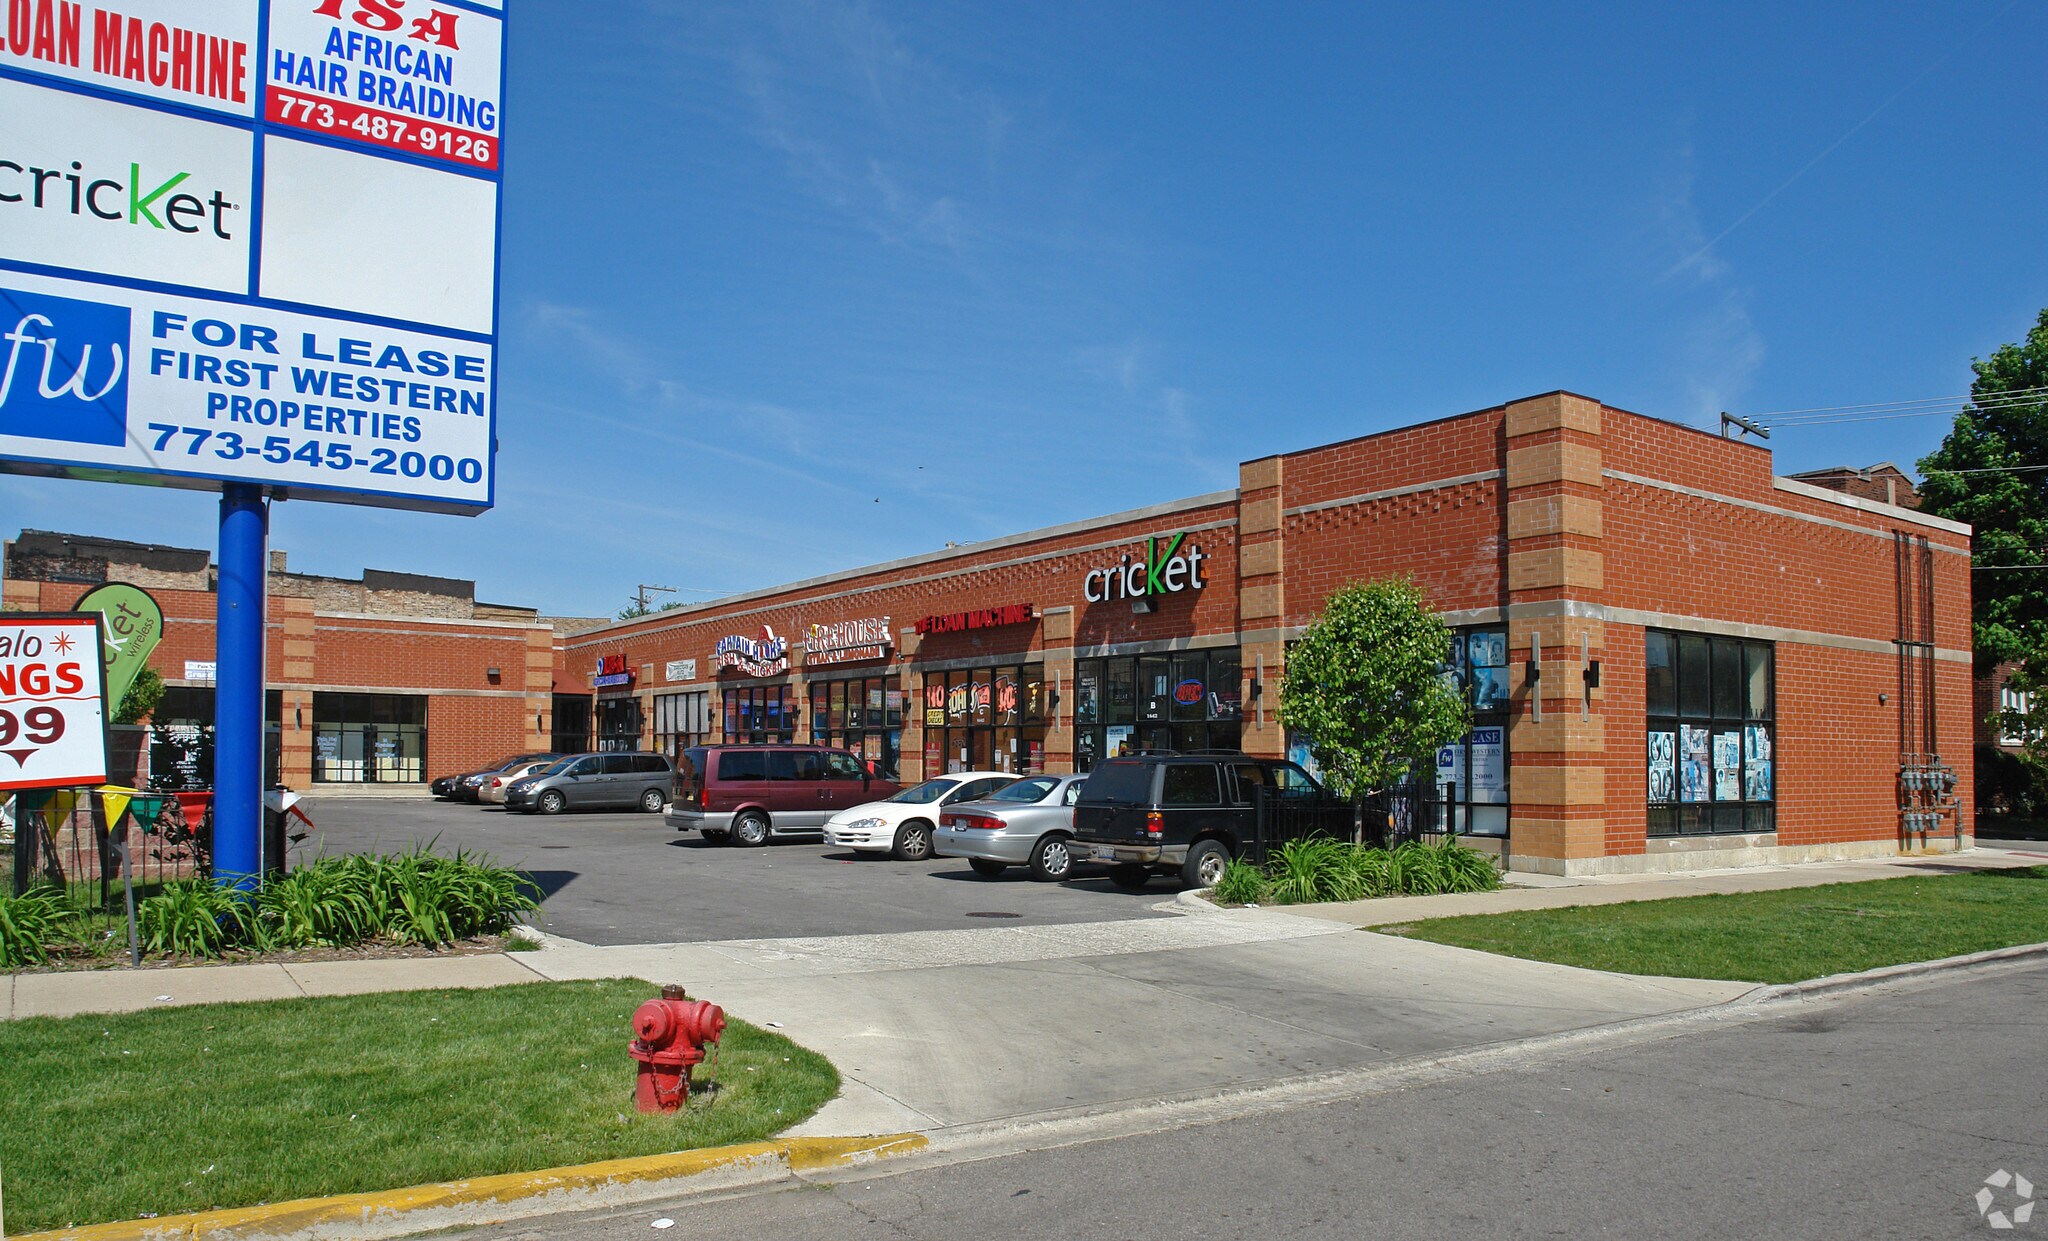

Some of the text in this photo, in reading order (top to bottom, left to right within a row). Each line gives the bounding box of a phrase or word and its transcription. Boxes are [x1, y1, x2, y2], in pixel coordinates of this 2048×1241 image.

[0, 0, 247, 104] OAN MACHINE
[324, 26, 453, 87] AFRICAN
[273, 48, 496, 132] HAIR BRAIDING
[277, 93, 490, 163] 773-487-9126
[151, 310, 486, 383] FOR LEASE
[150, 347, 485, 417] FIRST WESTERN
[207, 394, 421, 443] PROPERTIES
[147, 422, 483, 484] 773-545-2000
[127, 617, 155, 658] wireless
[802, 617, 889, 653] FIREHOUSE
[932, 612, 965, 633] LOAN
[968, 603, 1031, 628] MACHINE
[716, 635, 750, 656] CAPTAIN
[716, 653, 735, 670] FISH
[747, 659, 783, 677] CHICKEN
[1176, 684, 1203, 701] OPEN
[1472, 731, 1499, 743] EASE
